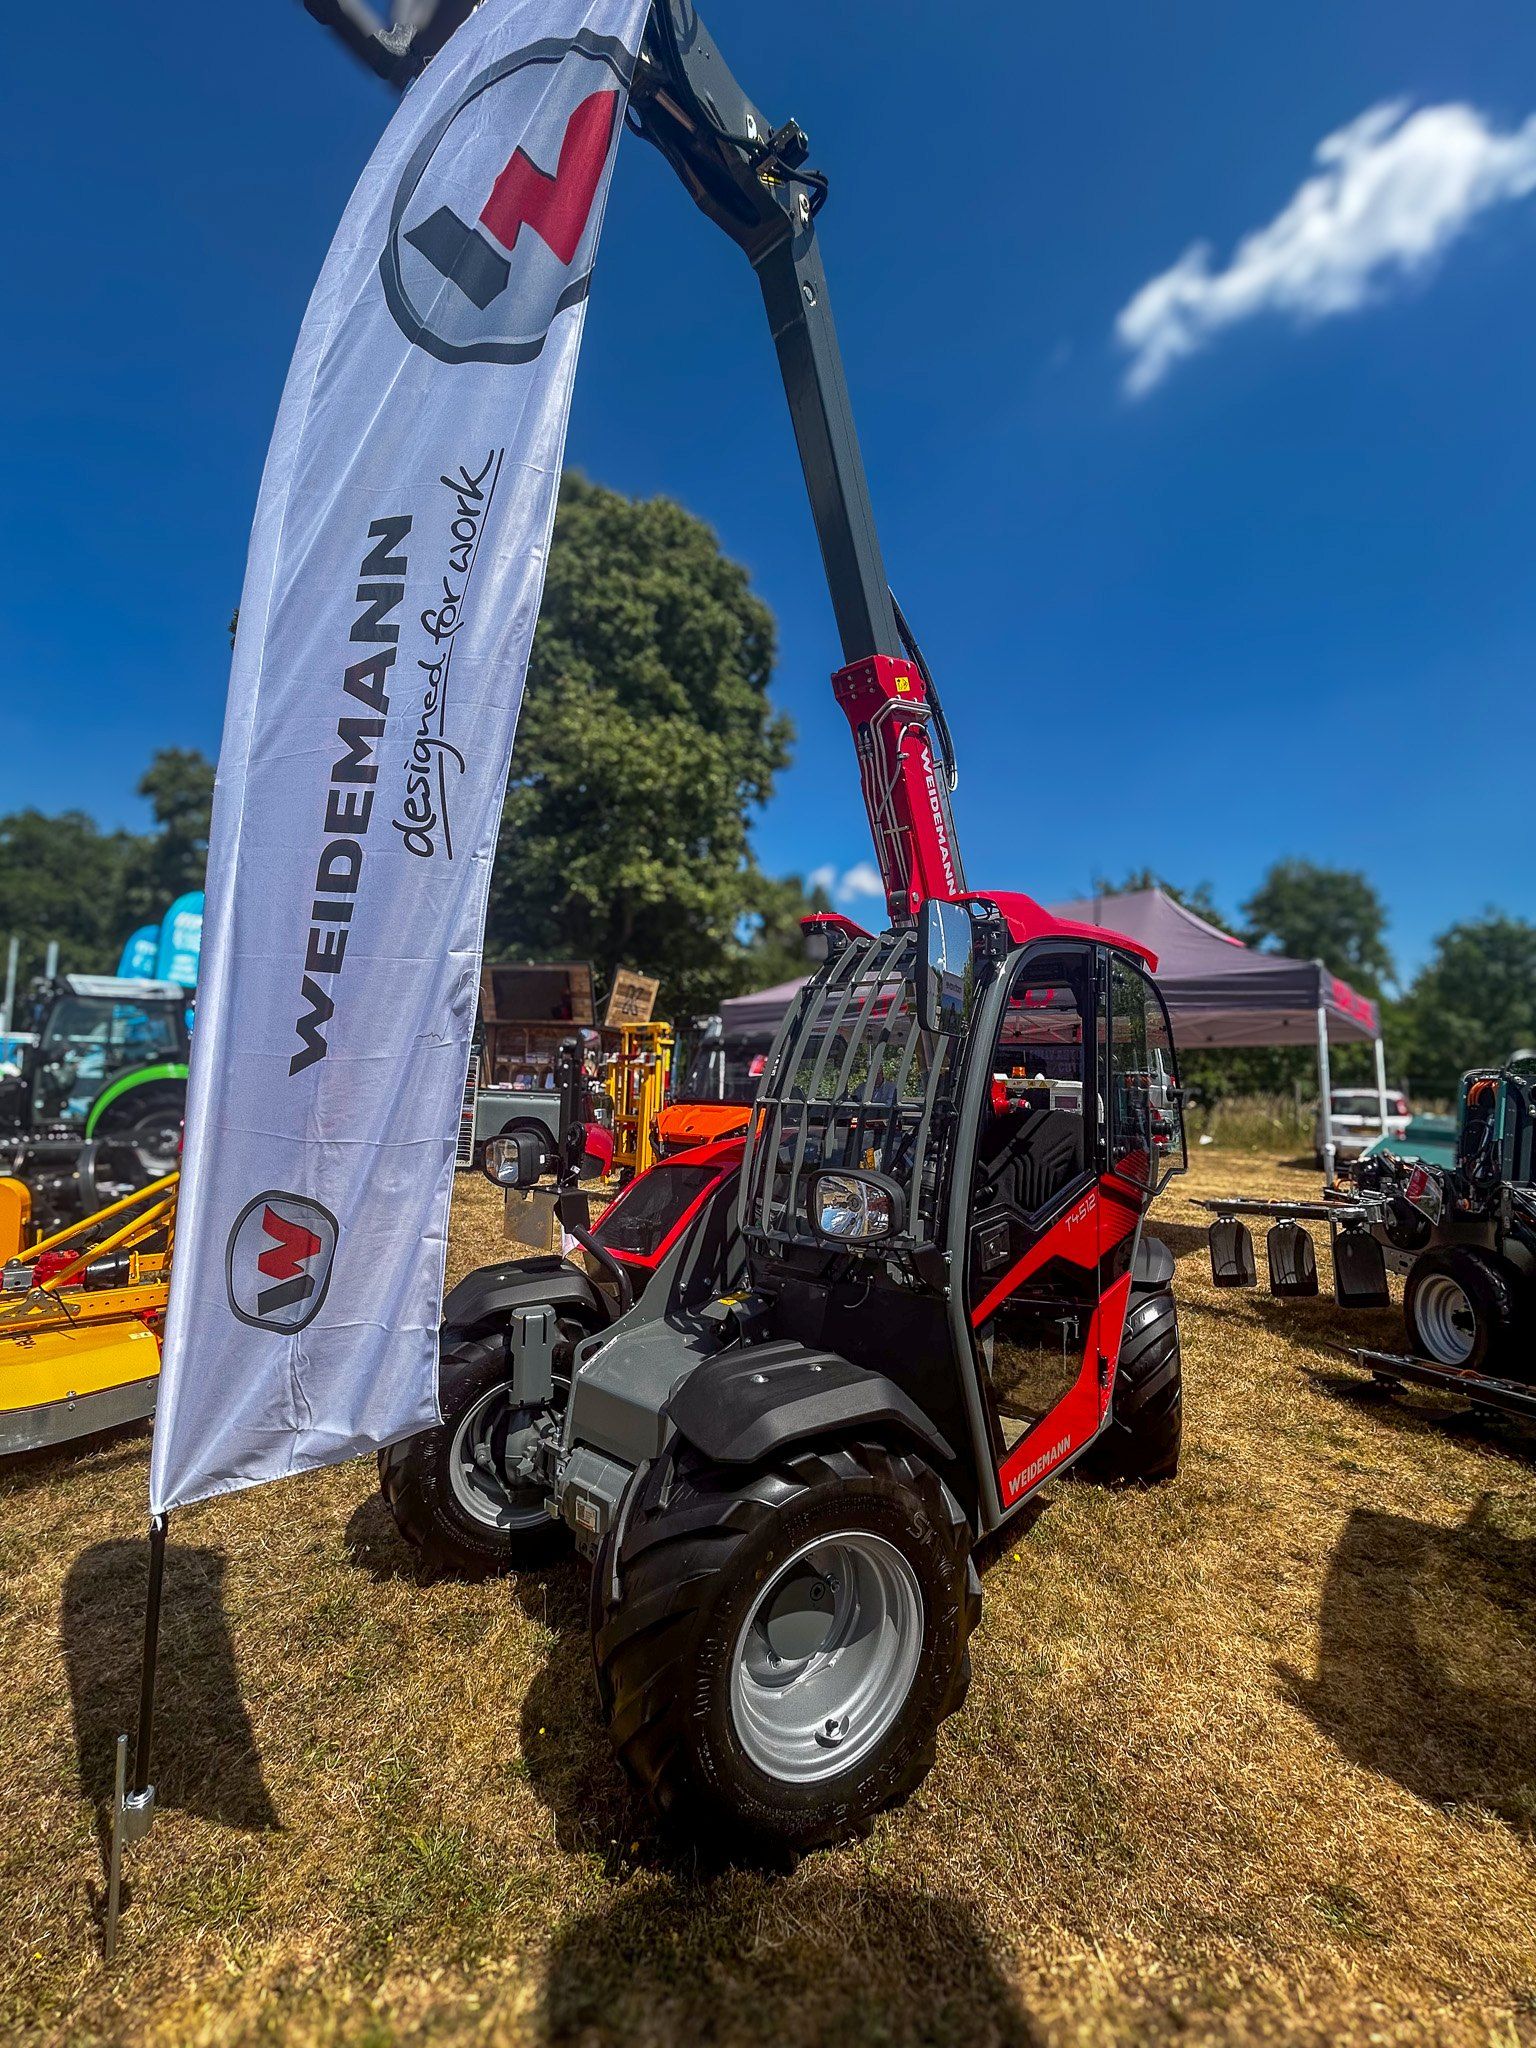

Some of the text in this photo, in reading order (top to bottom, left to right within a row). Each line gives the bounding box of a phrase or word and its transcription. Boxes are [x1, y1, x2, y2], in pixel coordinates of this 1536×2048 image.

[392, 449, 494, 858] designed for work
[289, 514, 413, 1077] WEIDEMANN
[921, 746, 956, 896] WEIDEMANN
[1065, 1193, 1096, 1232] T4512
[1008, 1434, 1071, 1496] WEIDEMANN
